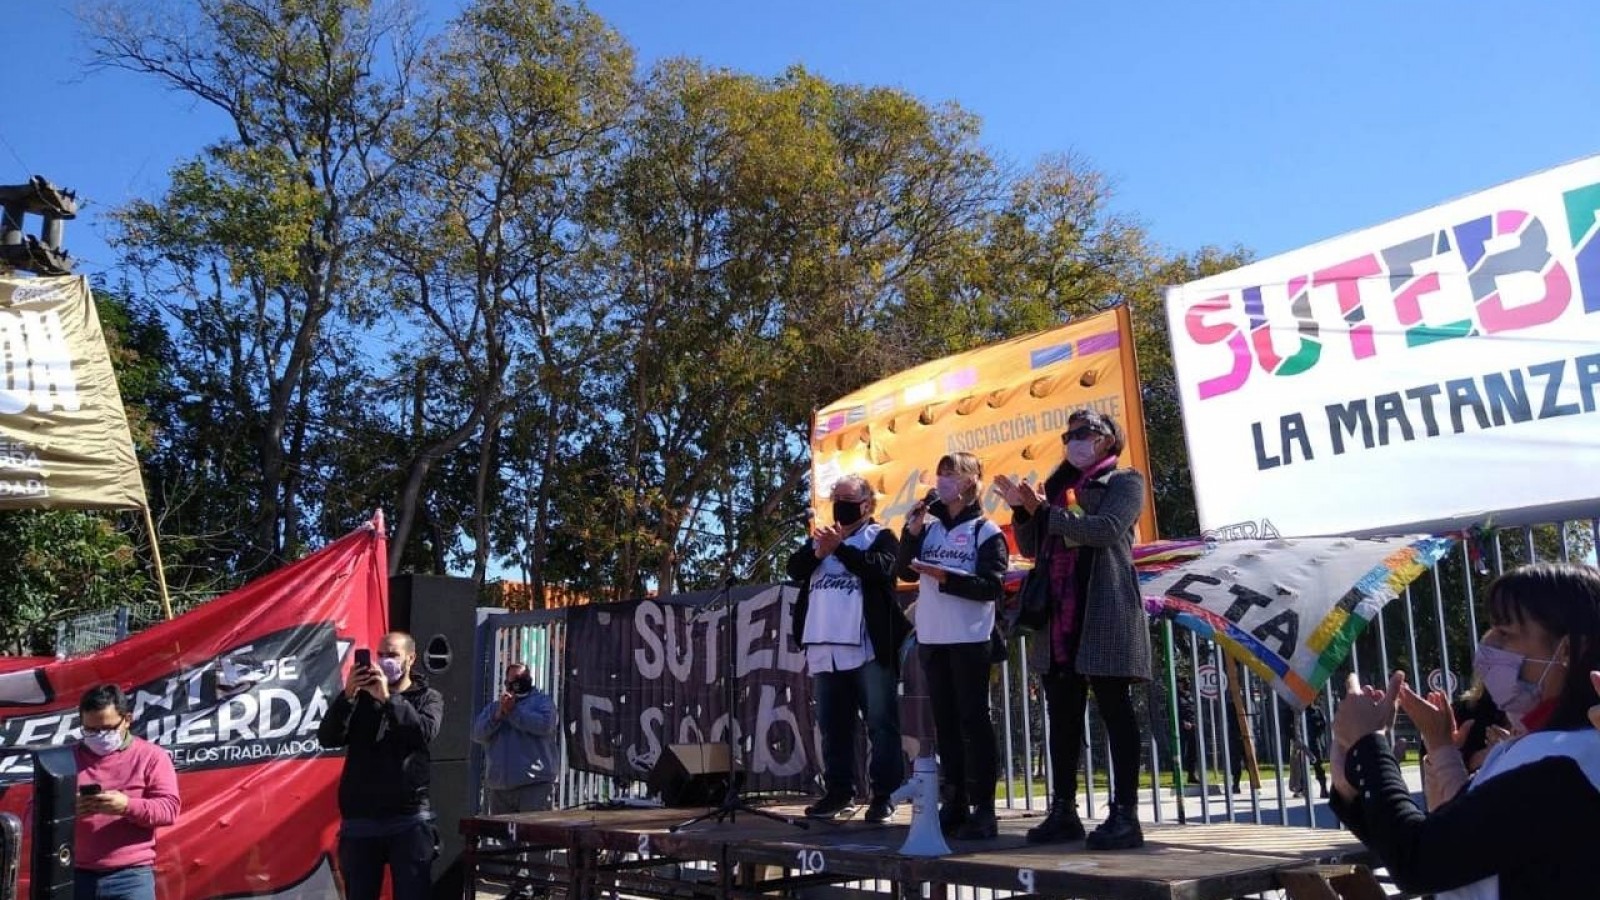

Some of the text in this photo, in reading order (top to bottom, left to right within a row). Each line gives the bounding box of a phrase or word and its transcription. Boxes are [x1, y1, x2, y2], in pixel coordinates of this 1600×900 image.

[1251, 412, 1314, 471] LA
[185, 746, 220, 764] LOS
[797, 850, 825, 873] 10
[1018, 868, 1035, 894] 9
